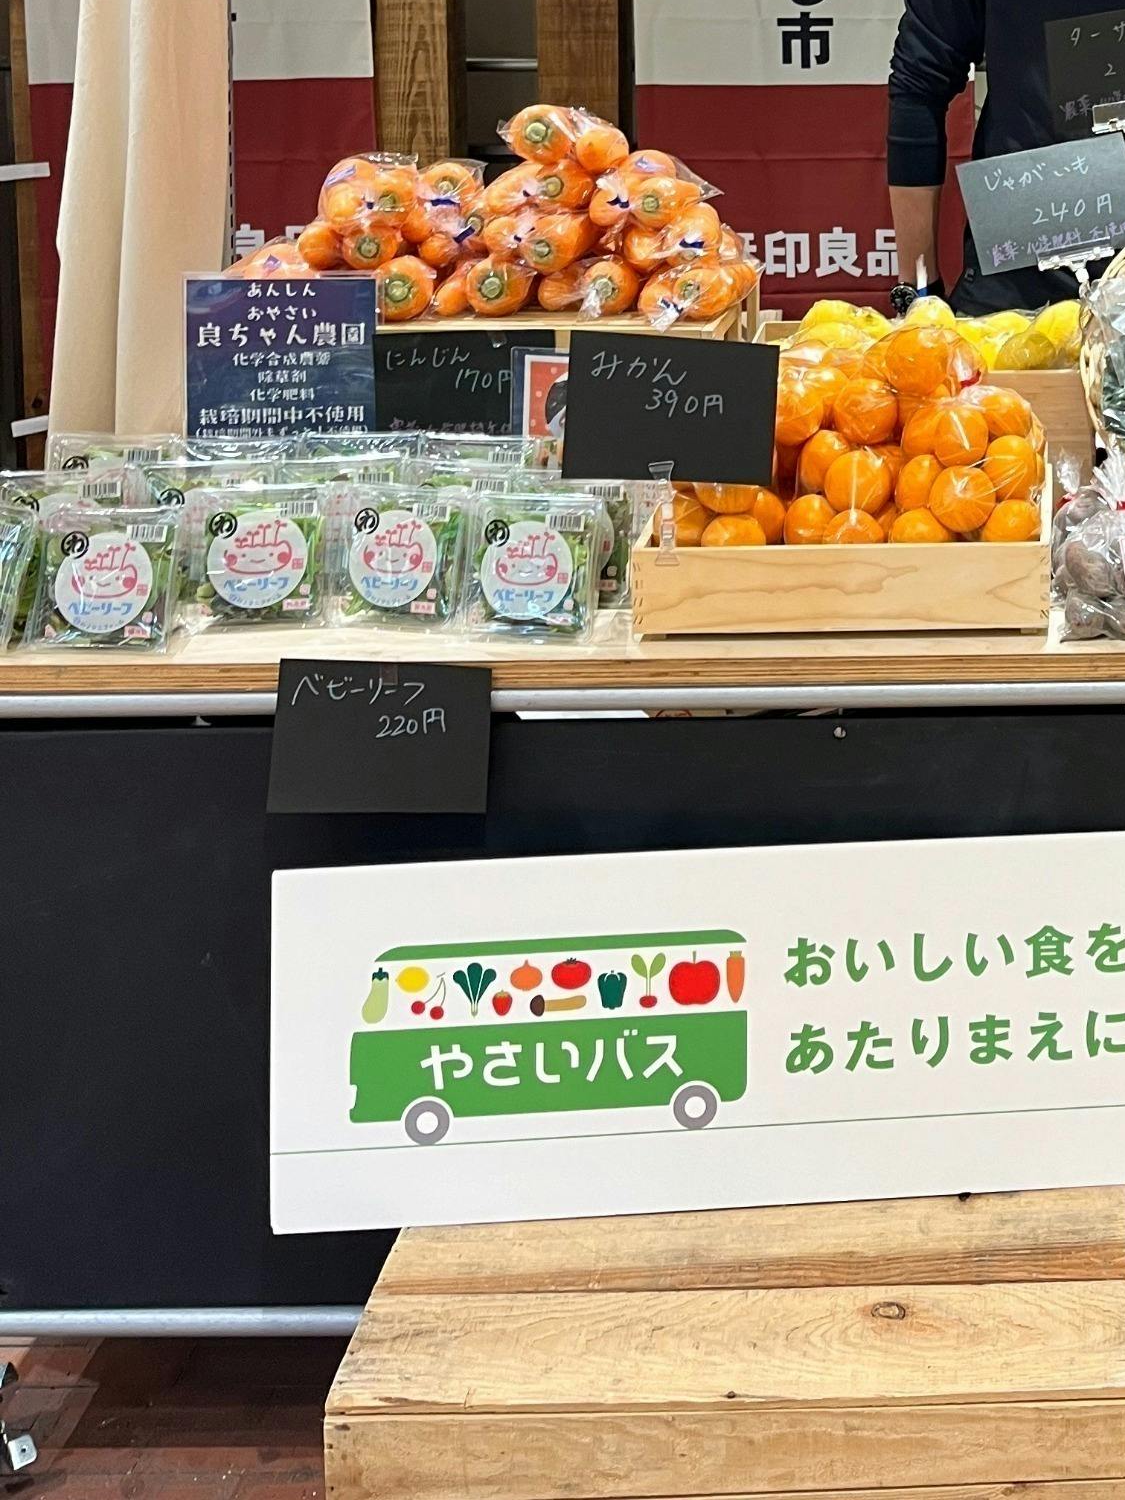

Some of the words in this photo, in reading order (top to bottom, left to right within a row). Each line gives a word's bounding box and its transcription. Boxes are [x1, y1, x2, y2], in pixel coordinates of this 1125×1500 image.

[983, 154, 1090, 193] じゃがいも
[1032, 192, 1113, 226] 240円
[736, 226, 899, 279] 印良品
[247, 282, 317, 298] あんしん
[247, 305, 317, 321] おやさい
[197, 322, 366, 347] 良ちゃん農園
[386, 346, 470, 371] にんじん
[591, 350, 688, 386] みかん
[645, 388, 724, 419] 390円
[291, 673, 425, 706] ベビーリーフ
[375, 708, 447, 739] 220円
[420, 1029, 684, 1090] やさいバス
